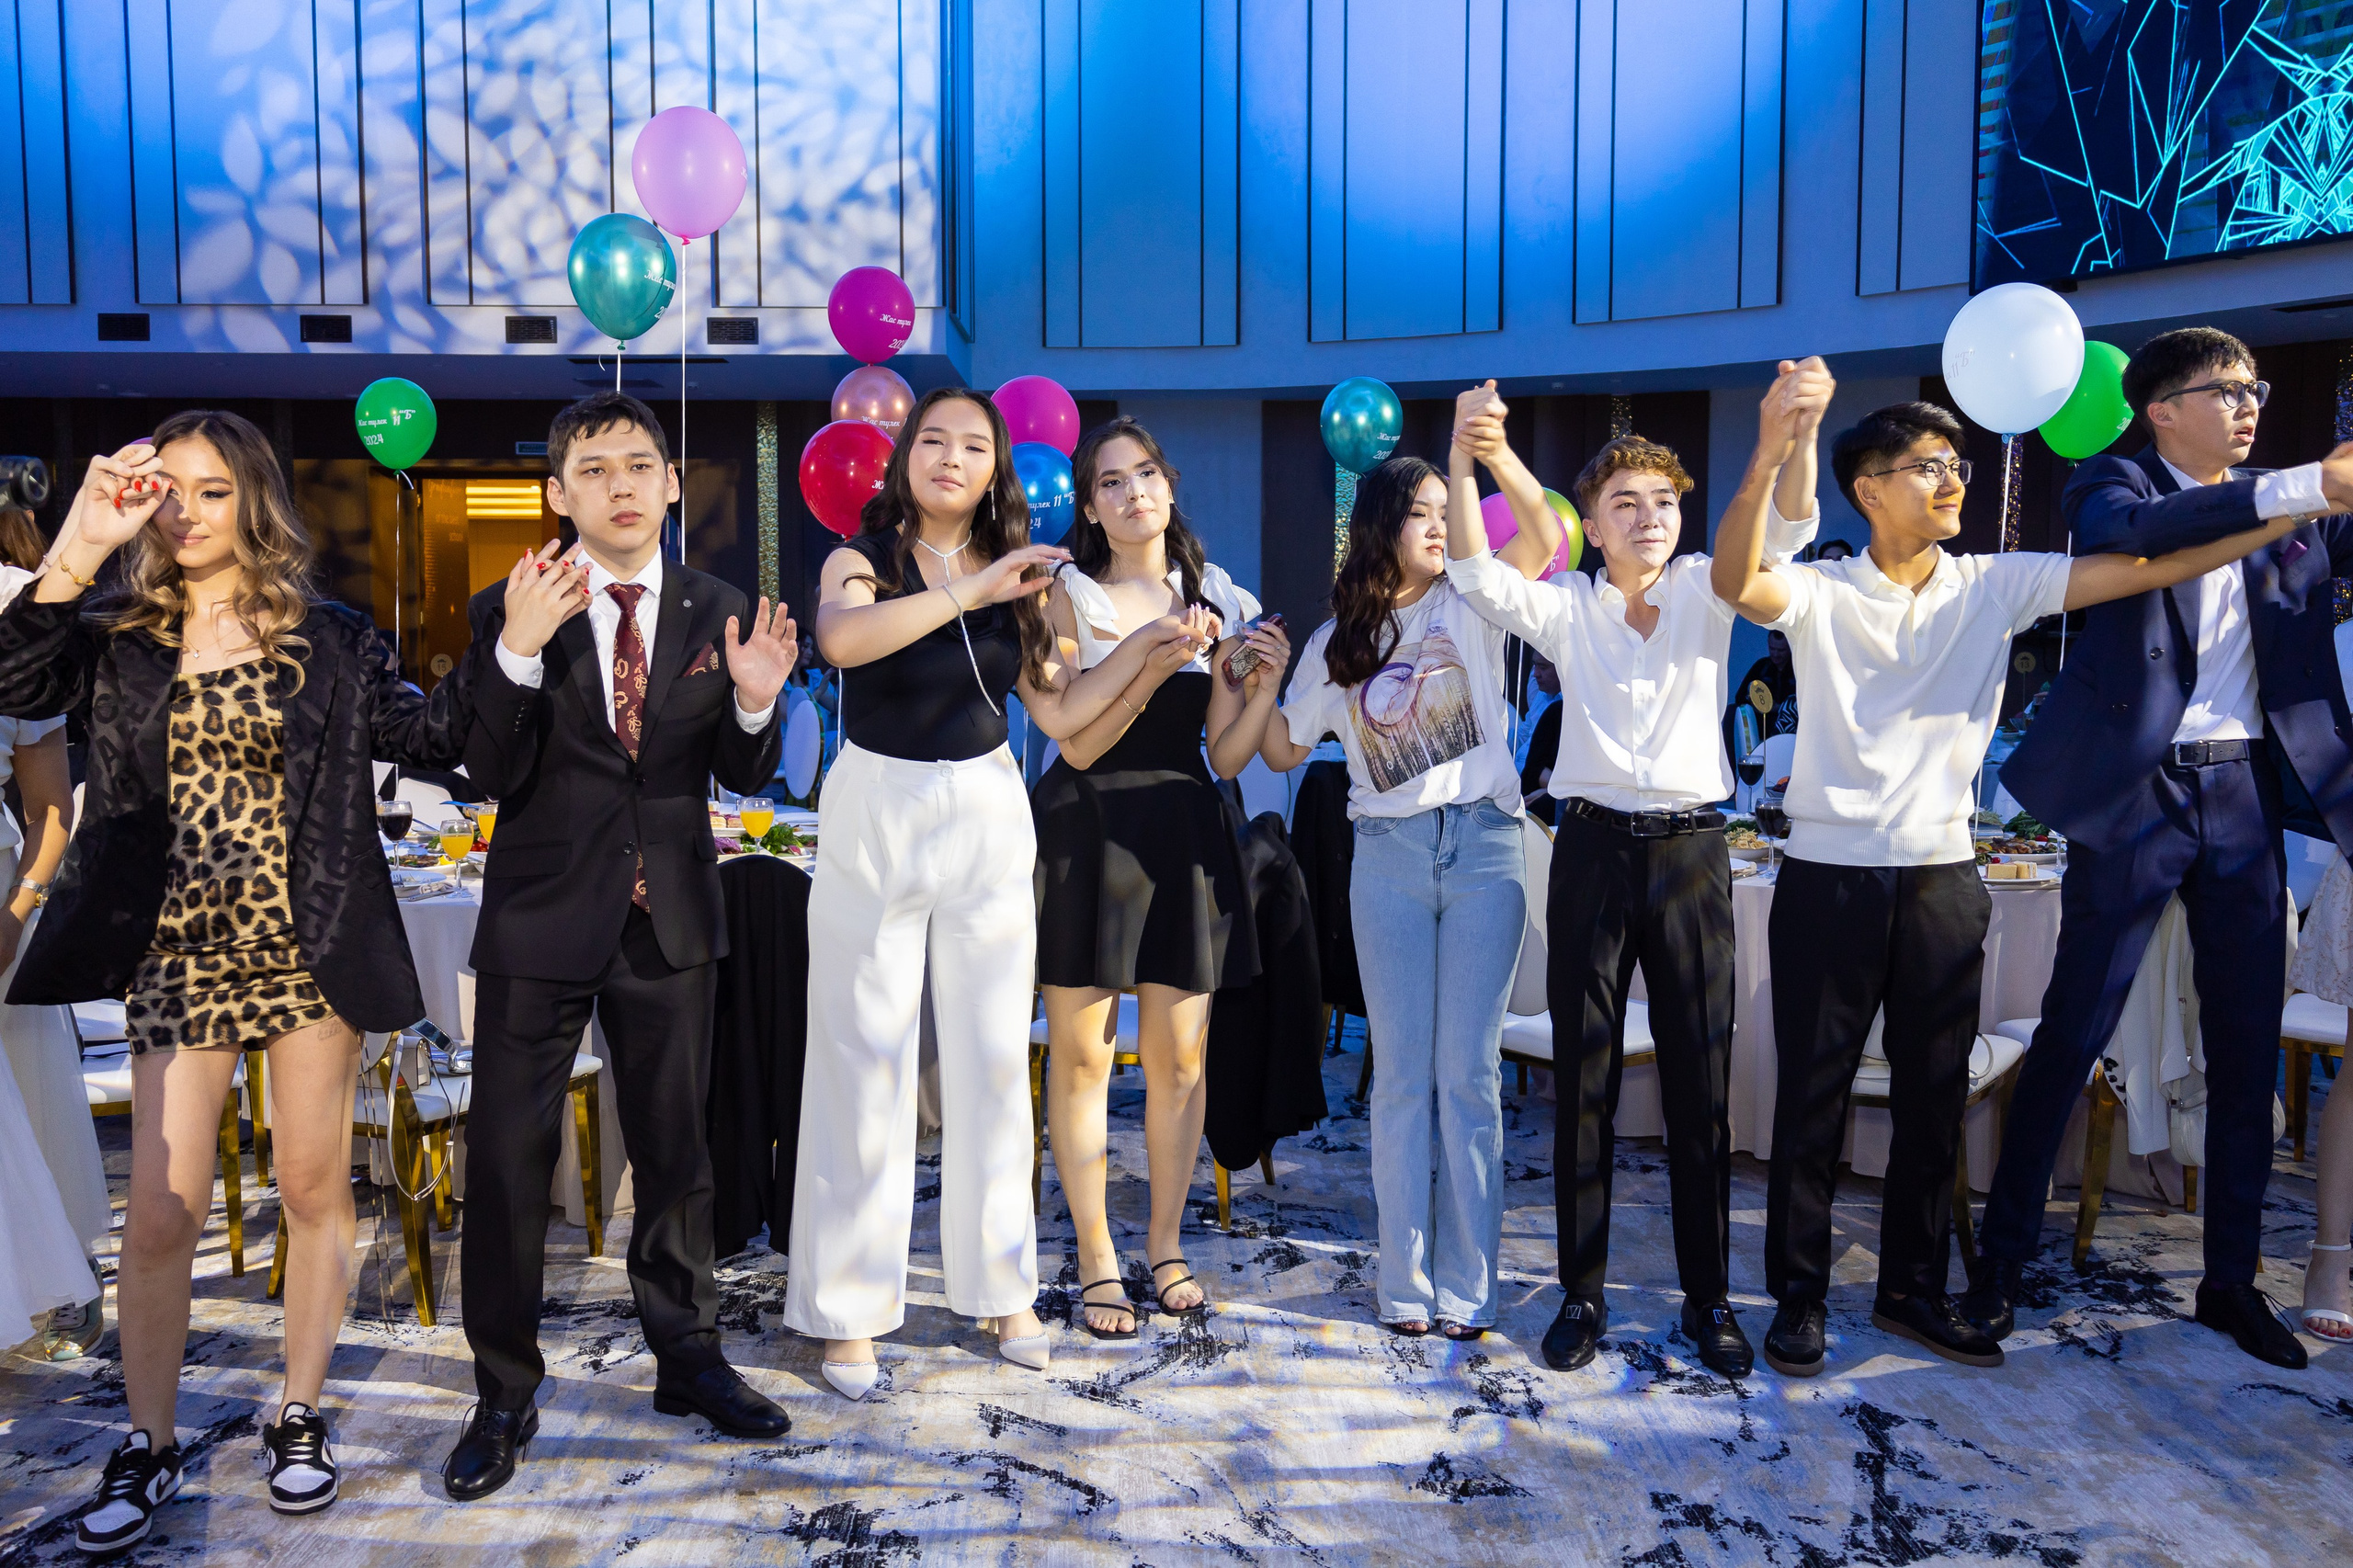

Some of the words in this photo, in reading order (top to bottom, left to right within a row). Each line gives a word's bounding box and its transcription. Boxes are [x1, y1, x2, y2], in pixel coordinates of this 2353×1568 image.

[880, 313, 897, 324] Жас
[392, 415, 401, 426] 11
[363, 433, 384, 446] 2024
[1053, 494, 1063, 507] 11
[2020, 660, 2029, 669] 13
[1758, 695, 1766, 705] 8
